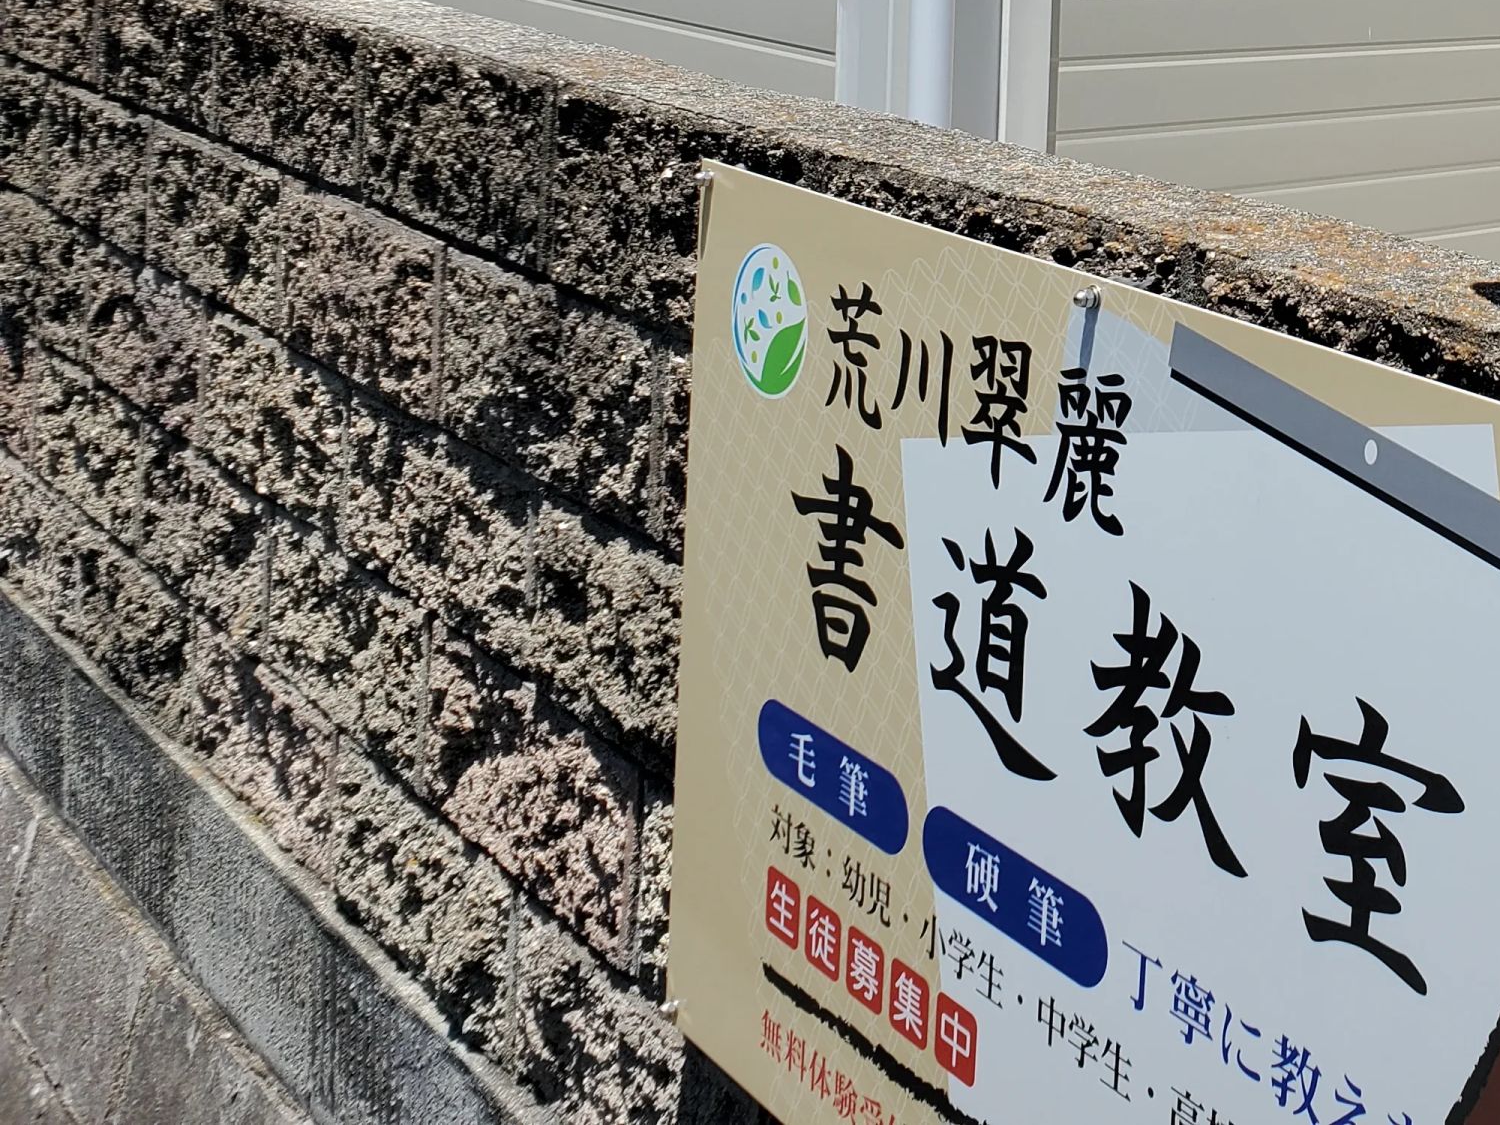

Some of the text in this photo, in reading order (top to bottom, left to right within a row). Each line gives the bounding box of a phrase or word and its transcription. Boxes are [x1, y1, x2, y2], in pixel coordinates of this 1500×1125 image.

[825, 281, 1133, 536] 荒川翠麗
[787, 732, 869, 817] 毛筆
[790, 443, 1466, 996] 書道教室
[769, 879, 972, 1068] 生徒募集中
[964, 841, 1064, 947] 硬筆
[1121, 940, 1413, 1125] 丁寧に教え
